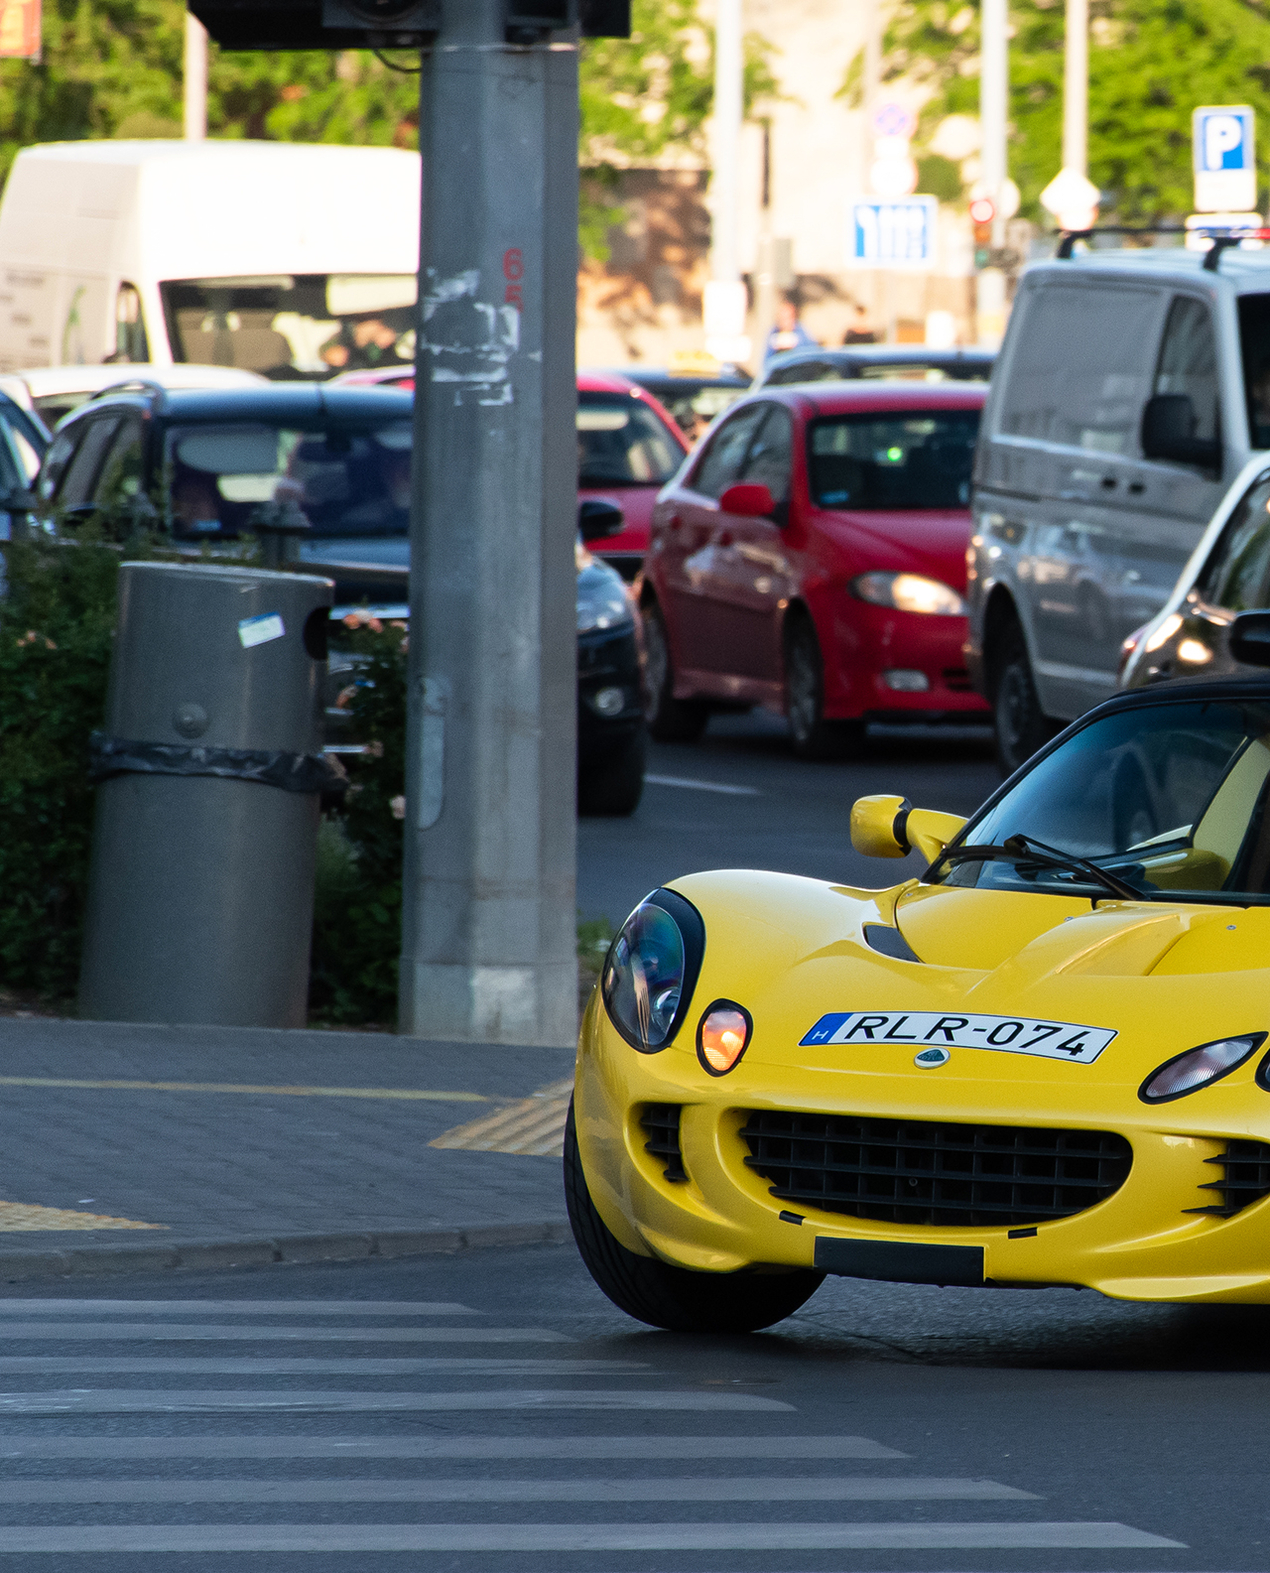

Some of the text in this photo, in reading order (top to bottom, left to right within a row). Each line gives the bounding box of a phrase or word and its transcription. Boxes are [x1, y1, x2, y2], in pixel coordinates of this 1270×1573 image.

[1206, 115, 1241, 170] P
[811, 1030, 826, 1041] H
[844, 1015, 1092, 1057] RLR-074
